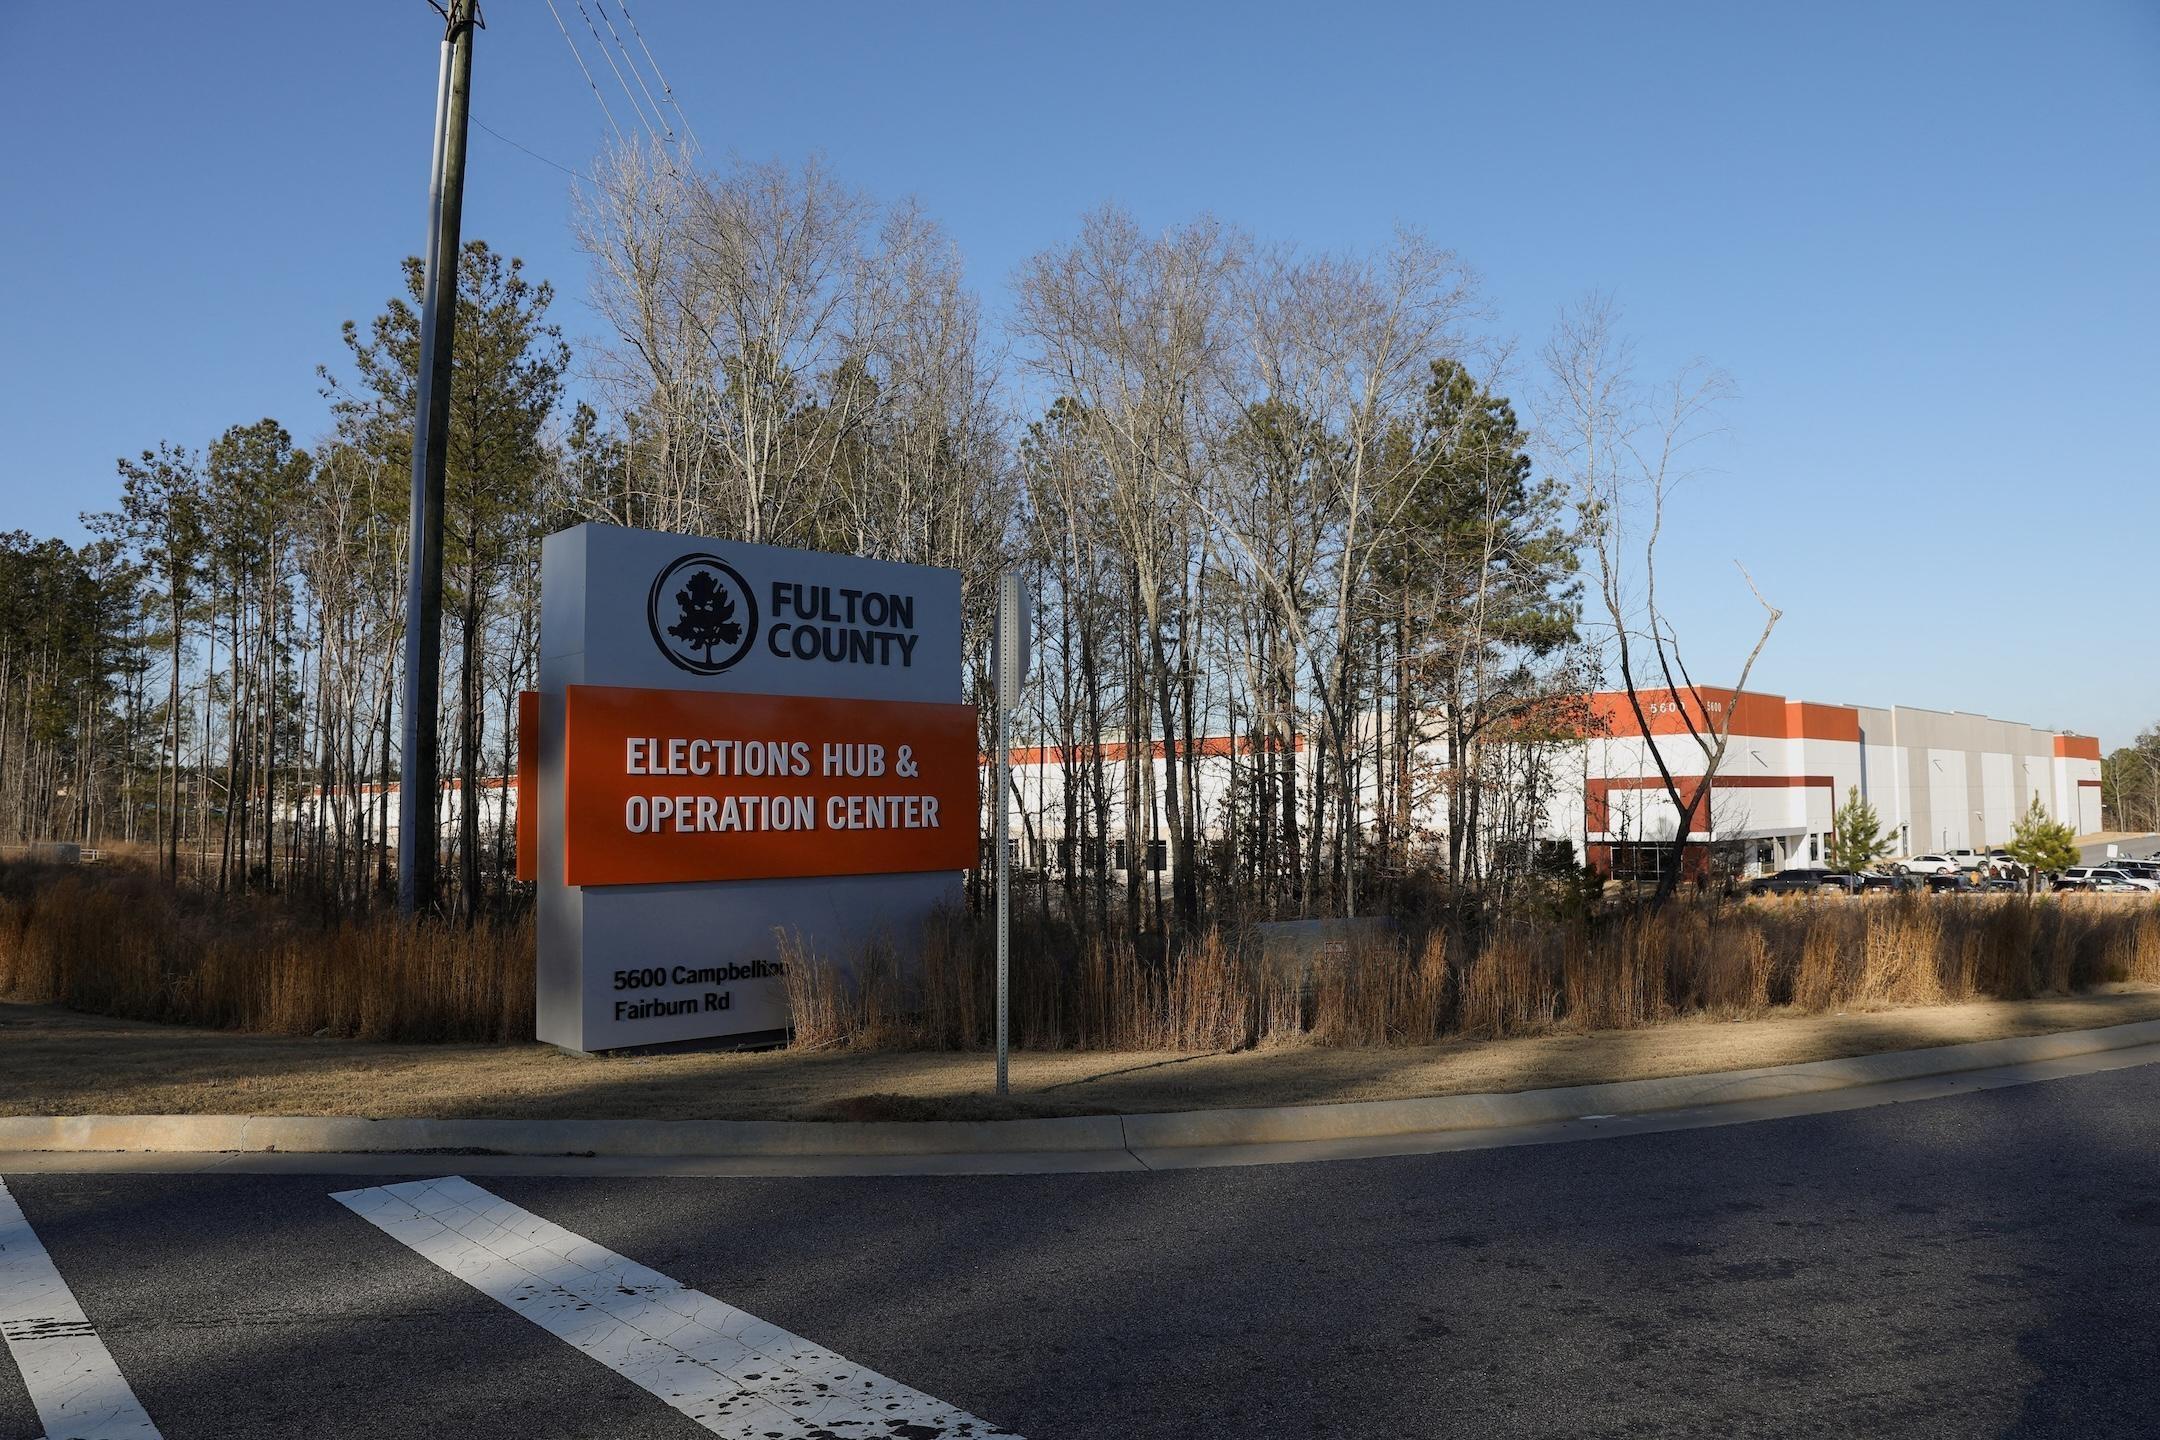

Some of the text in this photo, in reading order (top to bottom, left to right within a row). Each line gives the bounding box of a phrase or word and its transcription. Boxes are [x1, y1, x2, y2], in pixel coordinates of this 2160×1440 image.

[773, 581, 914, 629] FULTON
[768, 623, 919, 667] COUNTY
[1707, 701, 1722, 713] 5600
[626, 737, 919, 777] ELECTIONS HUB &
[625, 795, 940, 833] OPERATION CENTER
[613, 968, 667, 990] 5600
[615, 991, 730, 1021] Fairburn Rd
